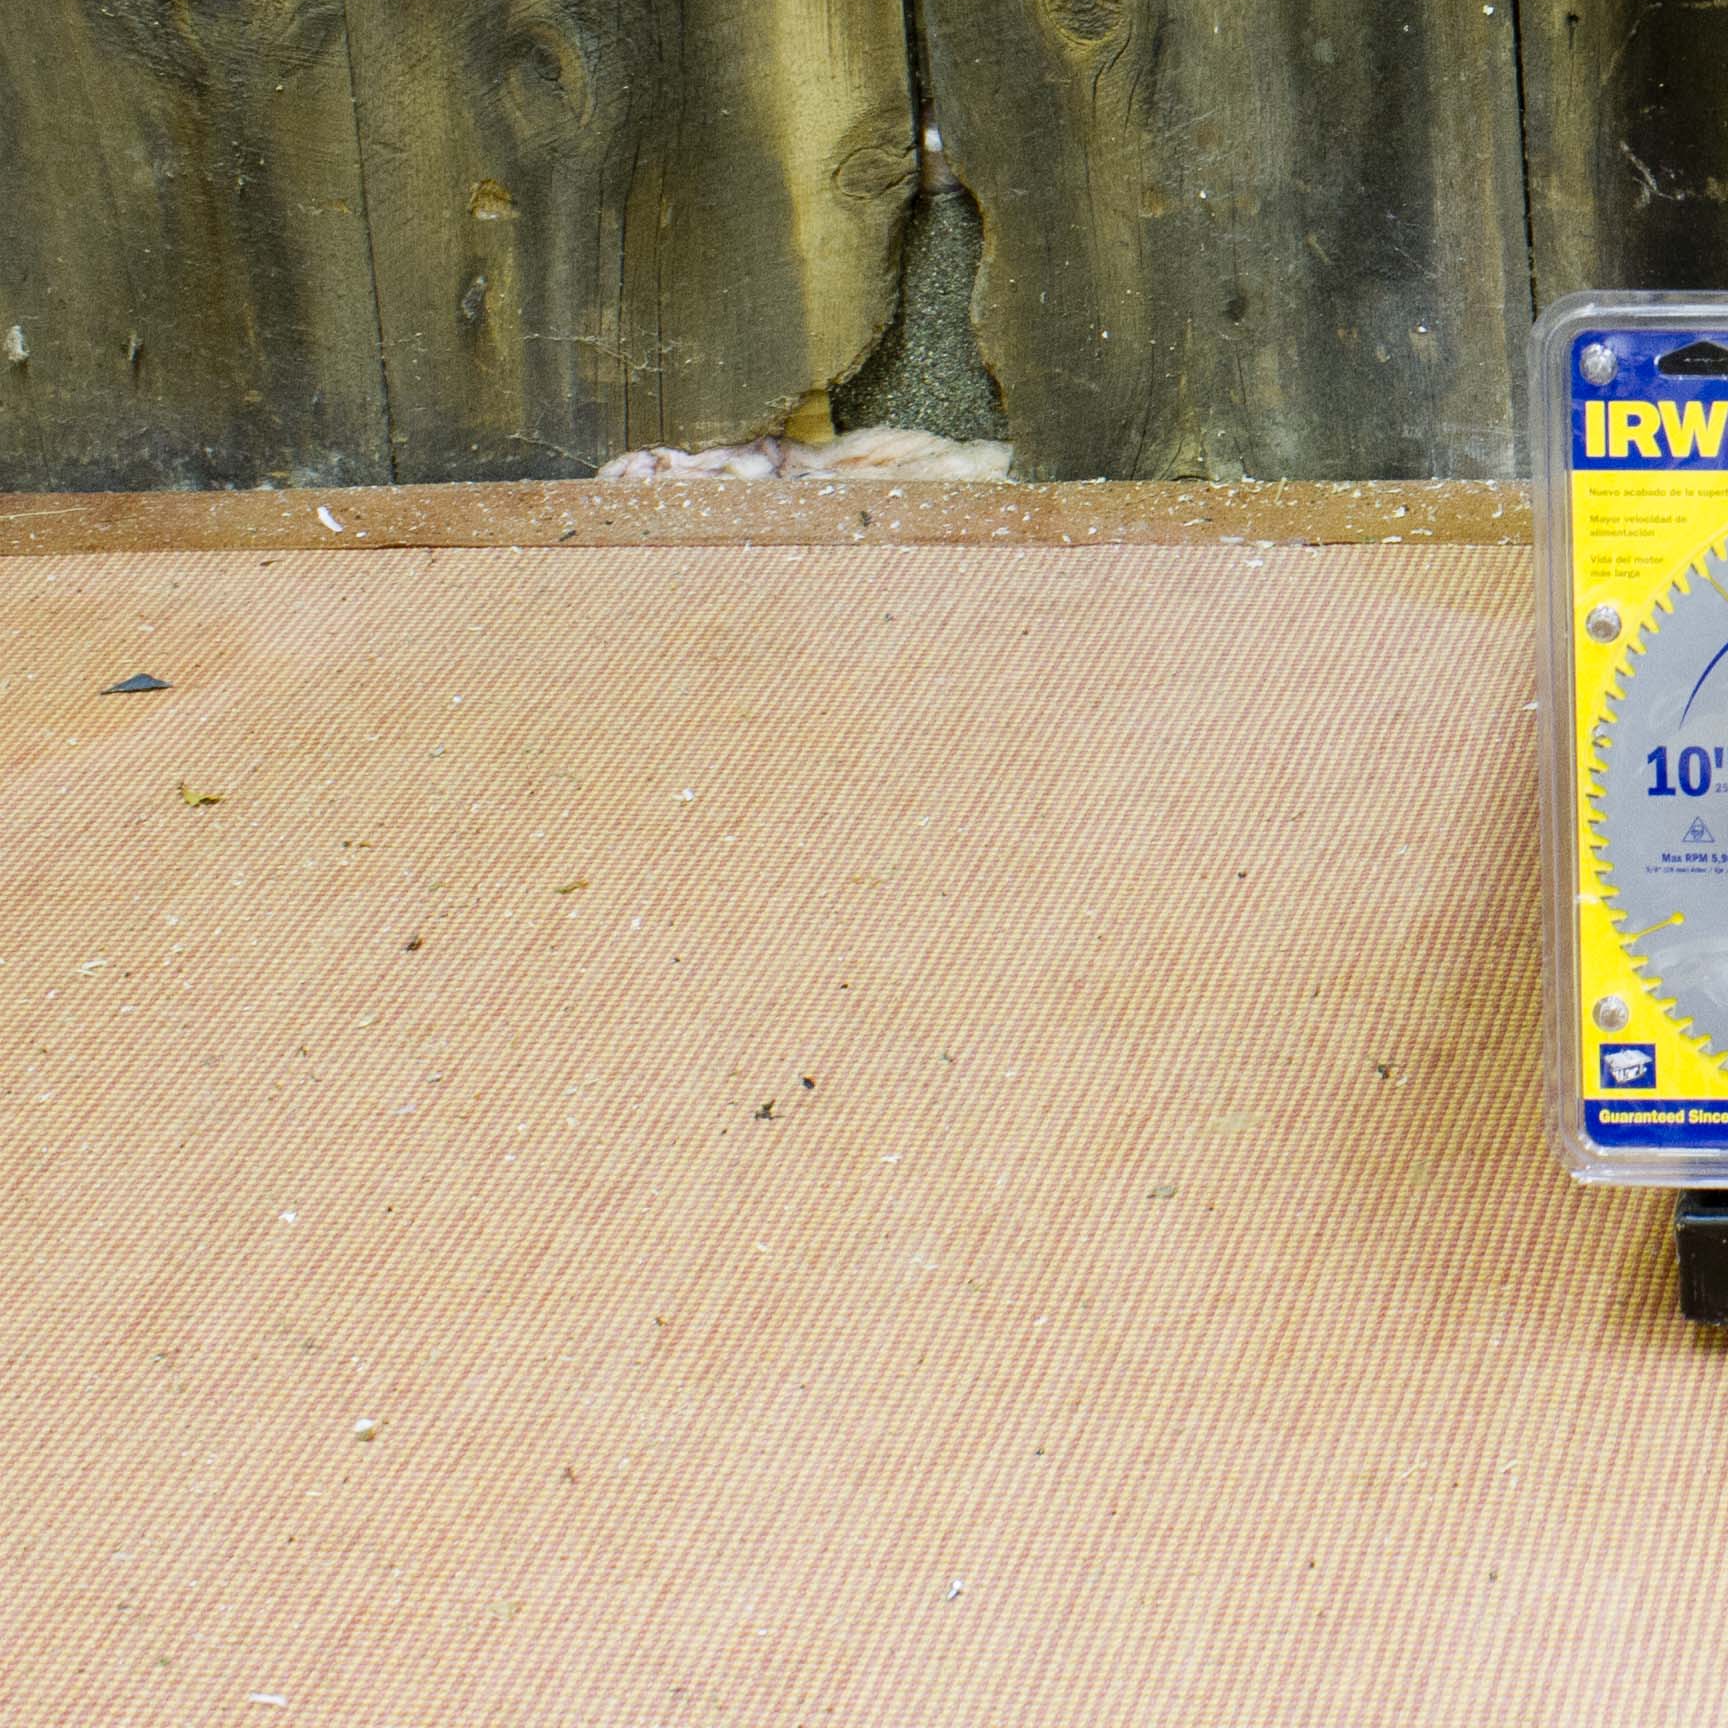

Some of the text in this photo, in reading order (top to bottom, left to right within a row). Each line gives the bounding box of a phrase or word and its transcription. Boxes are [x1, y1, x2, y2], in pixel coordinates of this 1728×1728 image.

[1589, 488, 1620, 497] Nuevo
[1624, 488, 1667, 497] acabado
[1670, 488, 1681, 496] de
[1685, 488, 1694, 496] la
[1590, 515, 1687, 526] Mayor velocidad de
[1591, 556, 1612, 564] Vida
[1616, 556, 1631, 564] del
[1615, 570, 1640, 579] larga
[1662, 854, 1707, 862] Max RPM
[1600, 1109, 1684, 1124] Guaranteed
